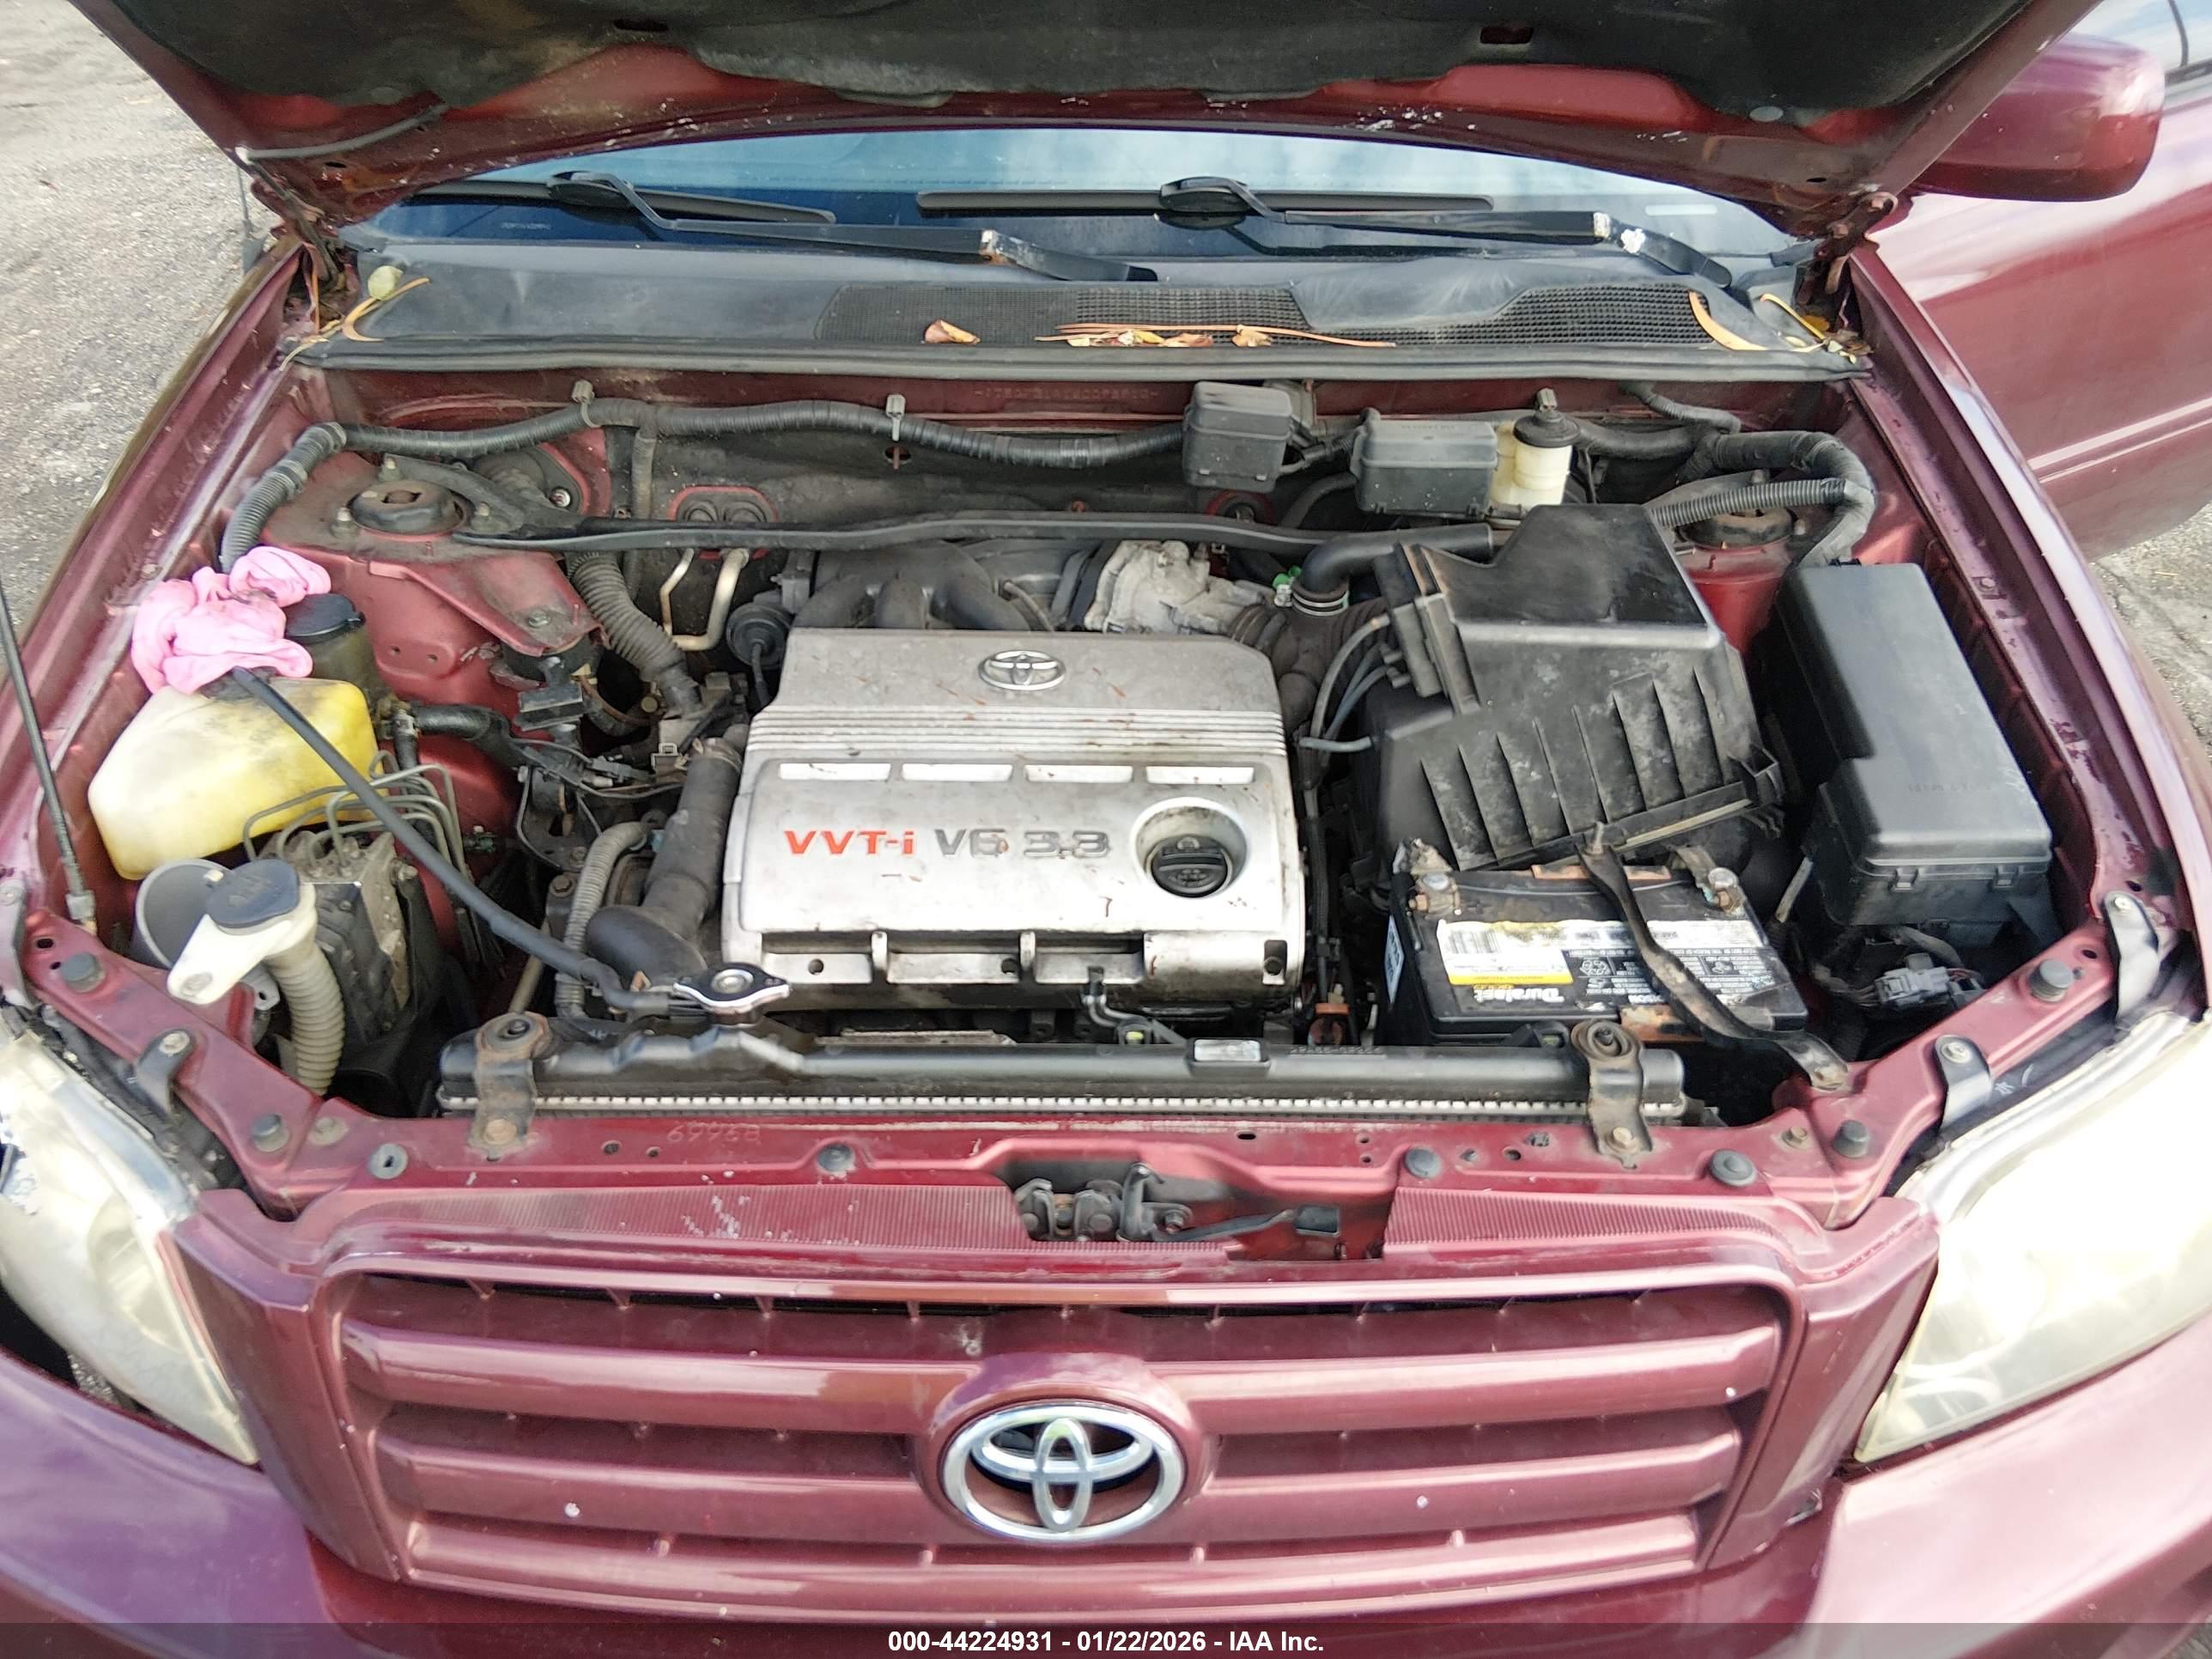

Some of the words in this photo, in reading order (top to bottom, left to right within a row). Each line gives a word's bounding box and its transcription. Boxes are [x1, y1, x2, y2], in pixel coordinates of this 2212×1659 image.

[784, 830, 915, 855] VVT-i
[935, 828, 1009, 859] V6
[1024, 830, 1111, 860] 3.3
[1474, 988, 1565, 1003] Duralast
